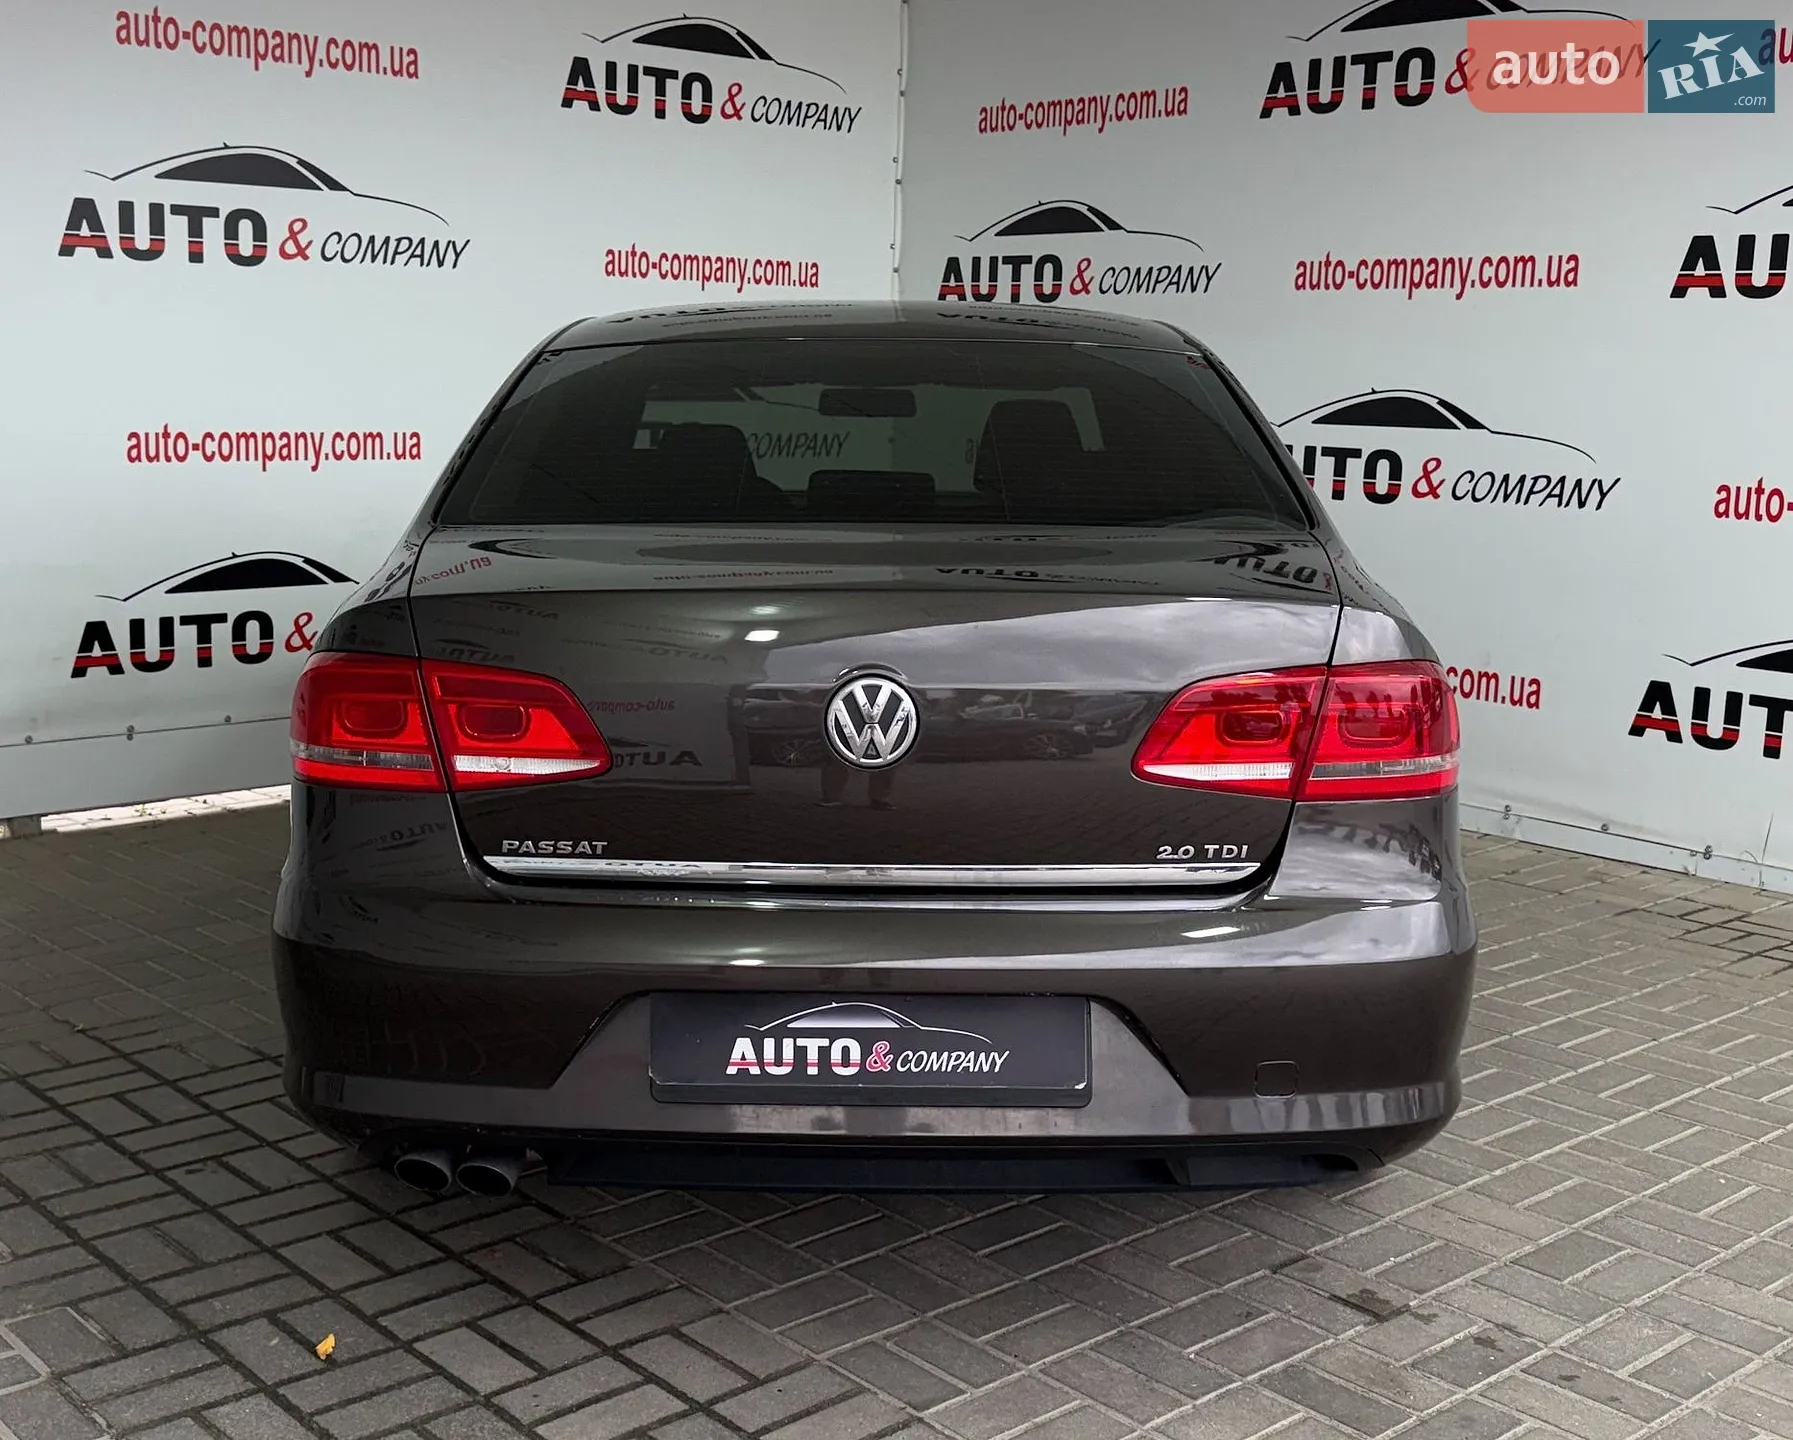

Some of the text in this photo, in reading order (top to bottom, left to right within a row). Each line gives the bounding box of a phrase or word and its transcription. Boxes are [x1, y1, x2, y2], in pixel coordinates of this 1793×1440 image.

[116, 6, 419, 79] auto-company.com.ua
[561, 55, 861, 133] AUTO & COMPANY
[1259, 46, 1436, 119] AUTO
[1444, 48, 1475, 94] &
[979, 85, 1188, 136] auto-company.com.ua
[58, 197, 470, 269] AUTO & COMPANY
[604, 243, 819, 289] auto-company.com.ua
[937, 254, 1221, 304] AUTO & COMPANY
[1295, 251, 1580, 300] auto-company.com.ua
[126, 423, 422, 472] auto-company.com.ua
[1411, 457, 1445, 500] &
[1451, 470, 1621, 511] COMPANY
[71, 610, 319, 679] AUTO &
[502, 840, 608, 854] PASSAT
[1204, 844, 1249, 859] TDI
[725, 1037, 1010, 1076] AUTO & COMPANY
